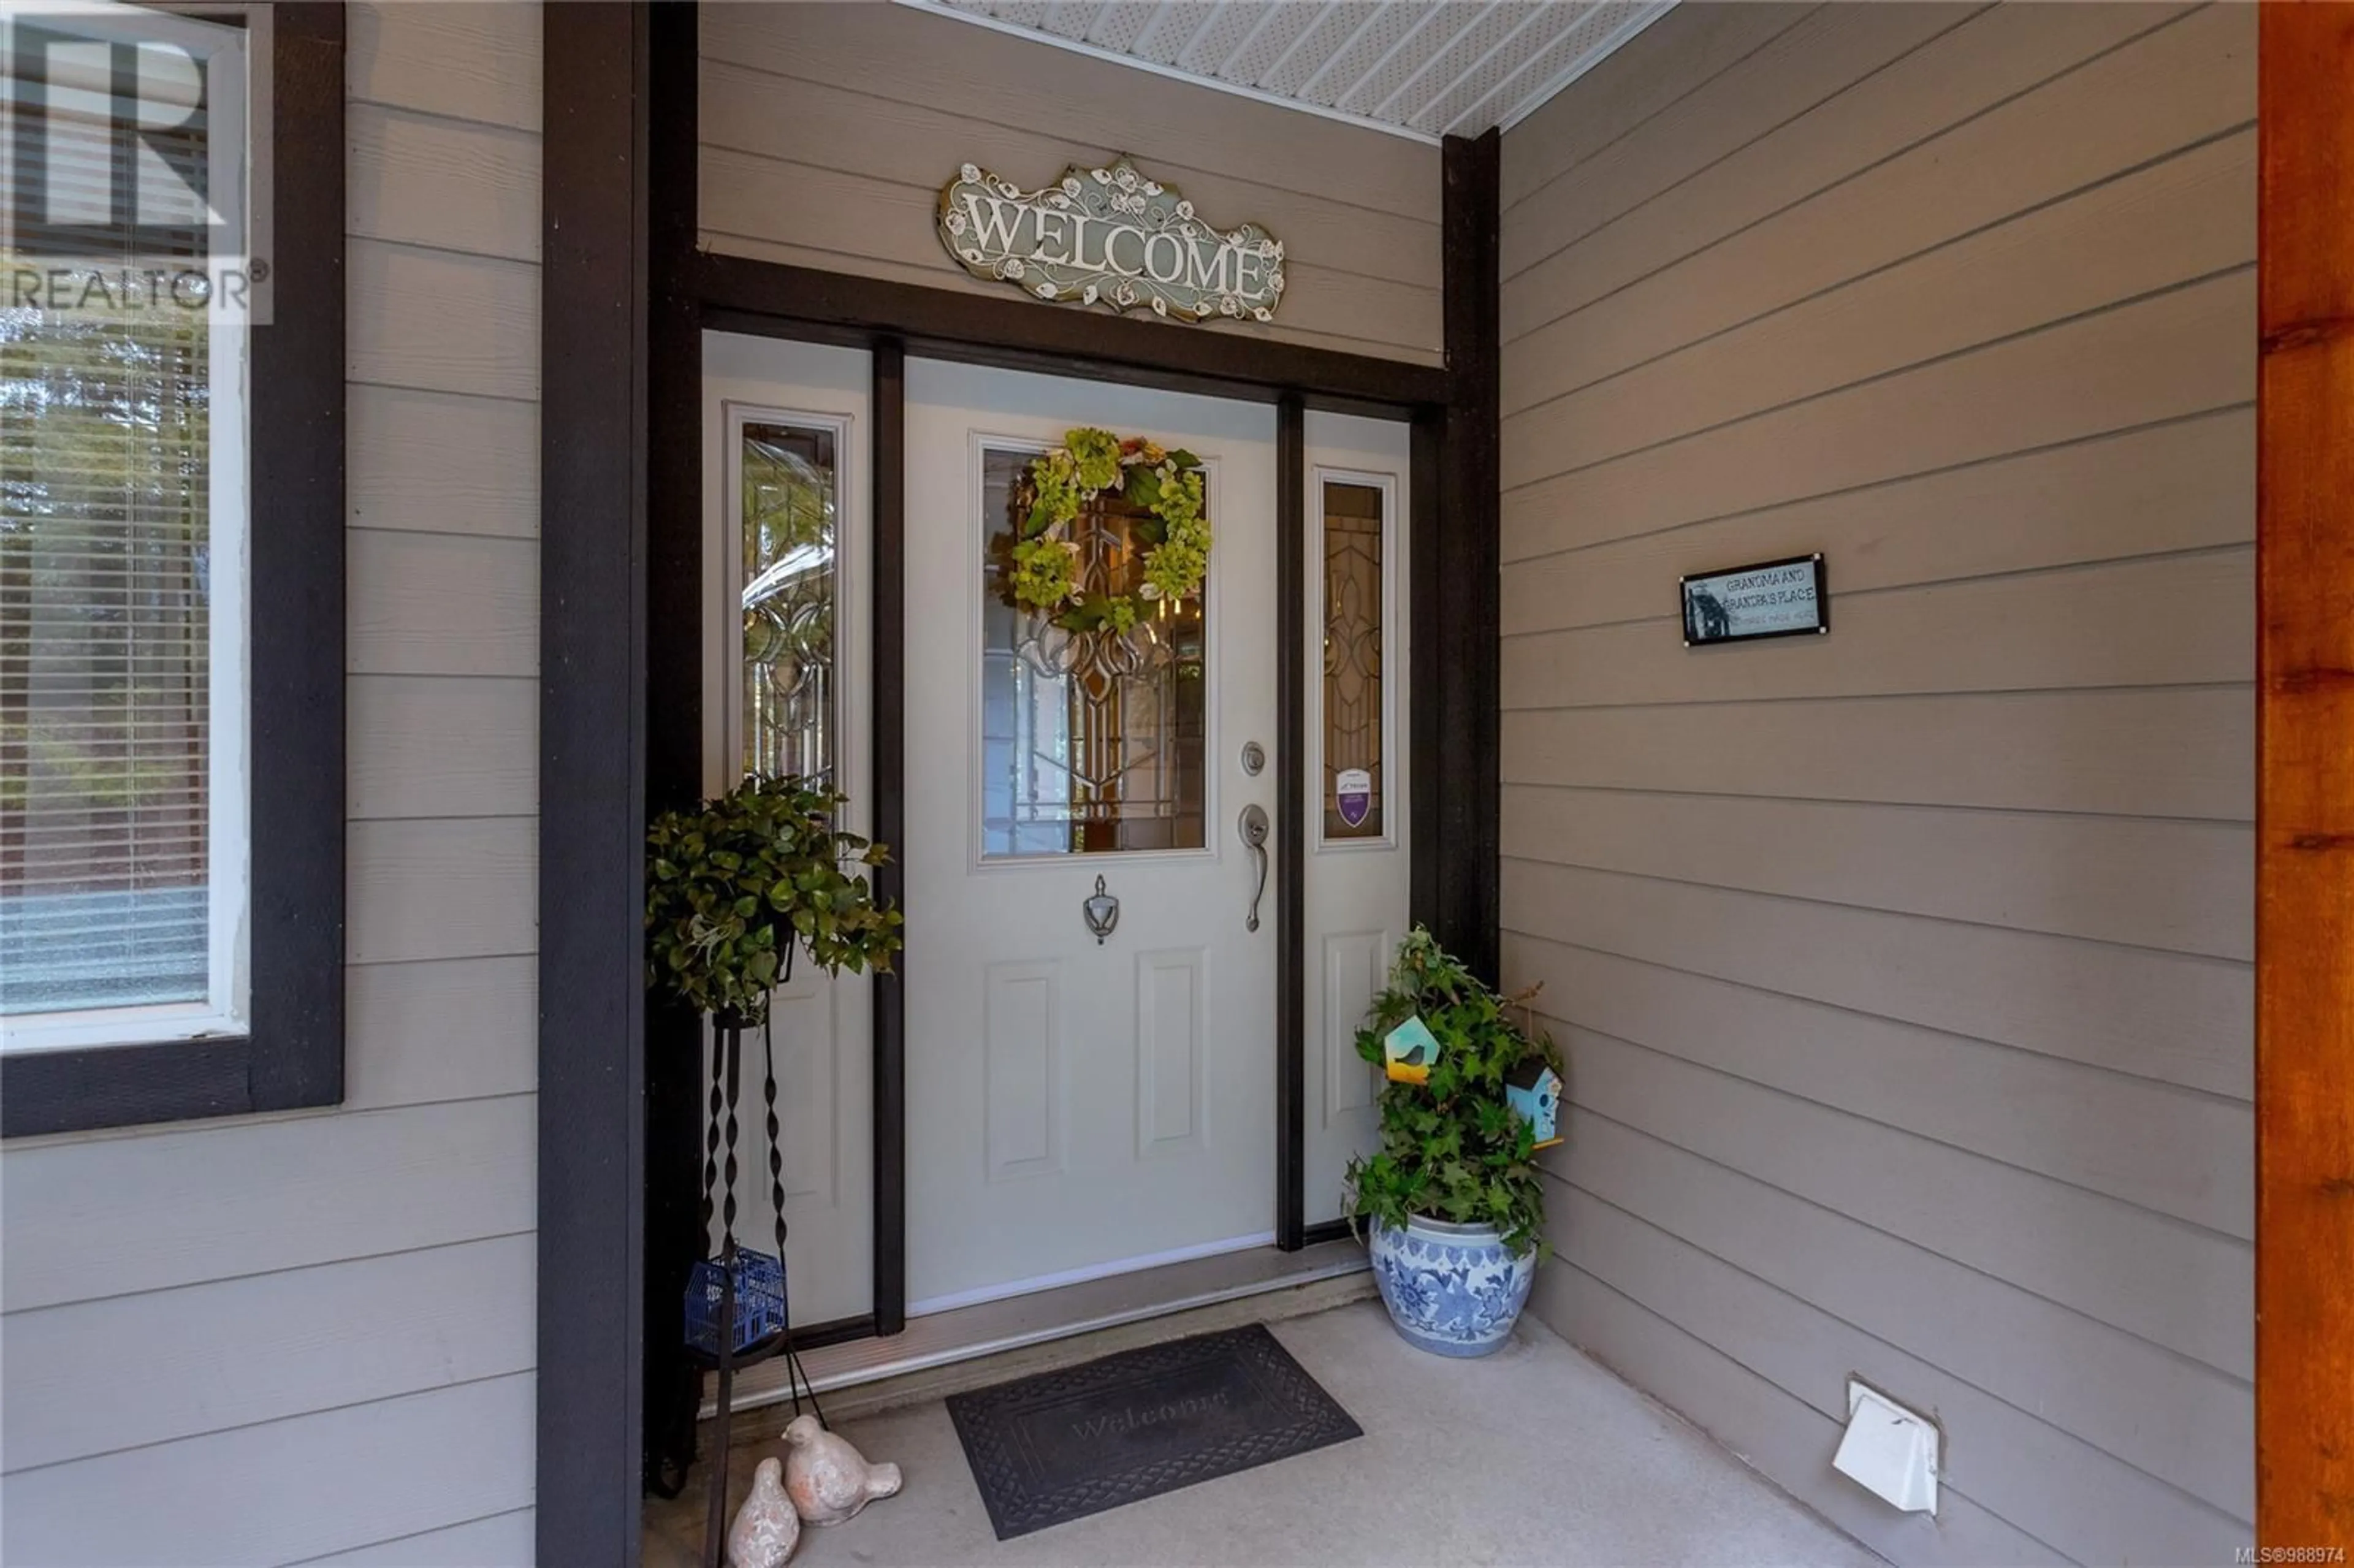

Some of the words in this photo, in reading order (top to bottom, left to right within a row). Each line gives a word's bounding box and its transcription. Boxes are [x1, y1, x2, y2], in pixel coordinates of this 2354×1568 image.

[962, 193, 1264, 300] WELCOME
[1726, 572, 1780, 592] GRANDMA
[1781, 568, 1805, 583] AND
[1777, 587, 1815, 606] PLACE
[1072, 1391, 1229, 1441] Welcome
